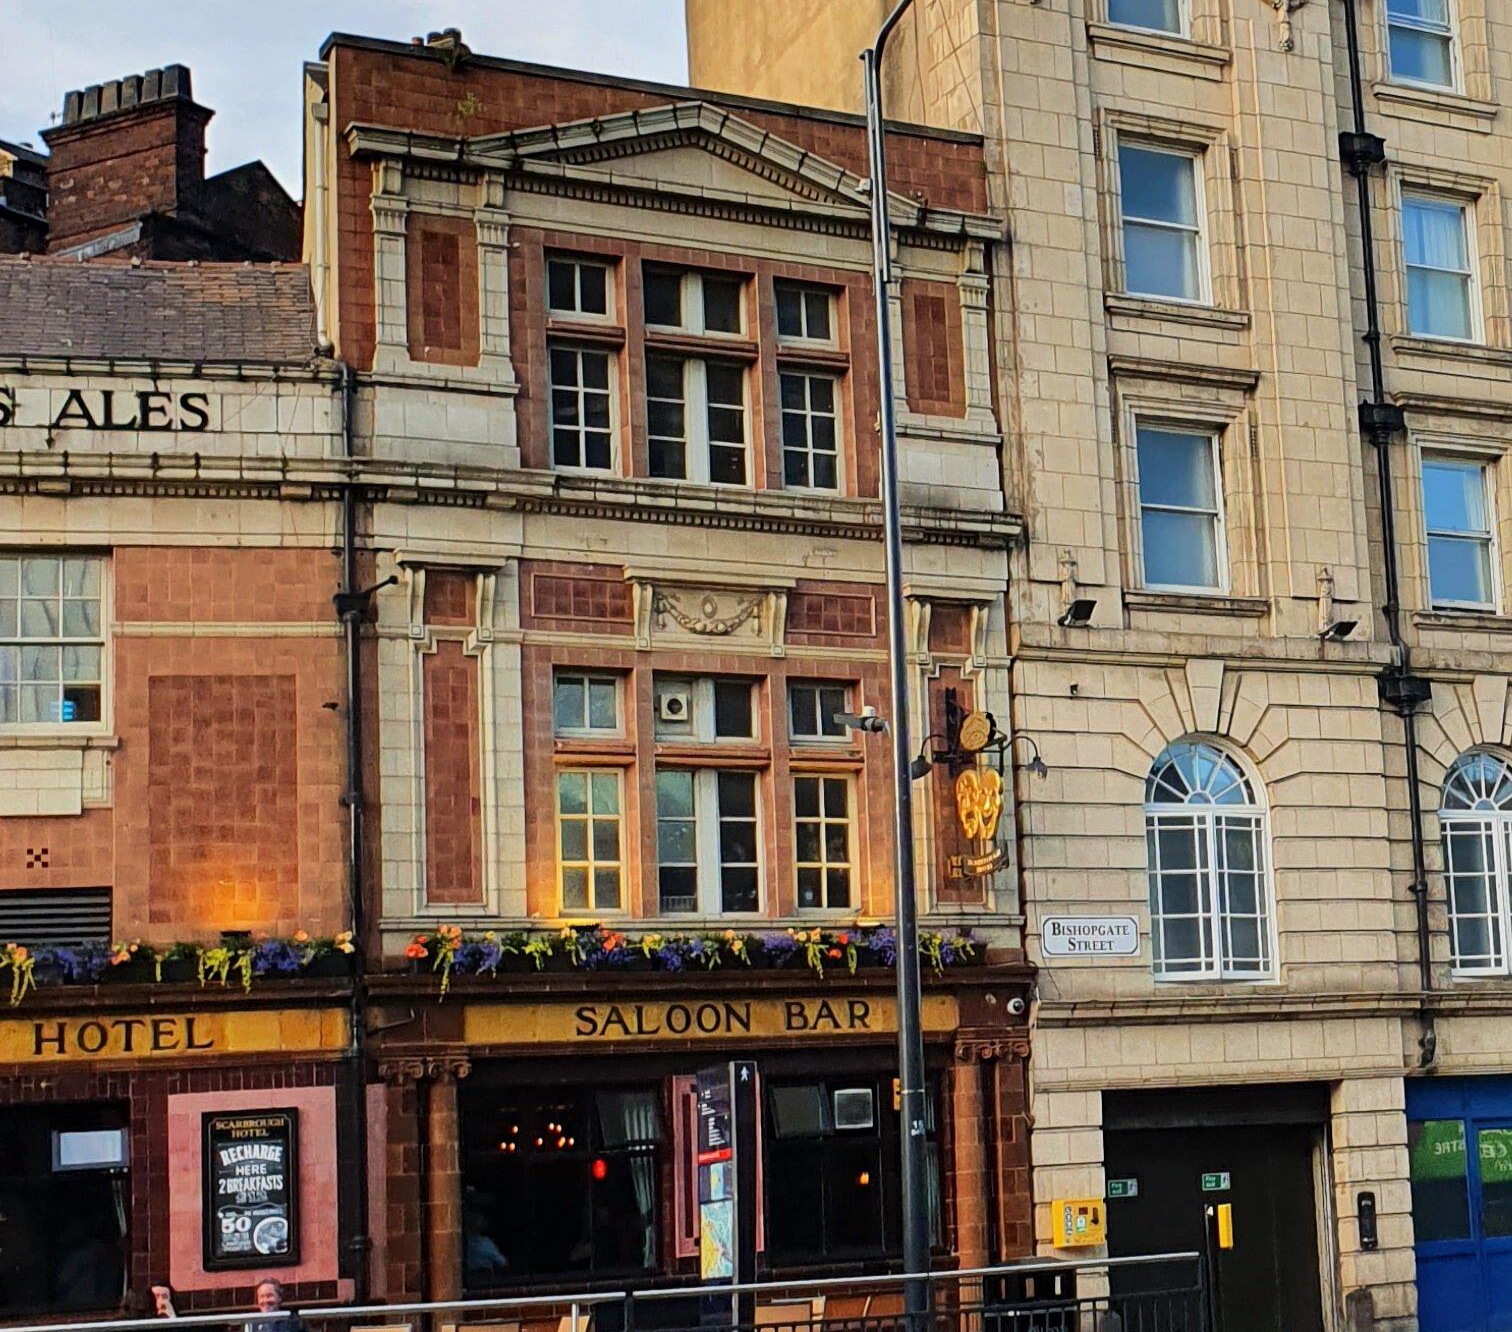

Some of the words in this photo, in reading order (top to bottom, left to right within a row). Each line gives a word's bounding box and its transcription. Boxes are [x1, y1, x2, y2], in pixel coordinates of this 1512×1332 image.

[51, 389, 210, 431] ALES
[1051, 922, 1130, 936] BISHOPGATE
[1068, 937, 1115, 951] STREET
[576, 1001, 750, 1036] SALOON
[784, 999, 871, 1031] BAR
[33, 1017, 215, 1055] HOTEL
[219, 1144, 284, 1166] RECHARGE
[235, 1164, 267, 1176] HERE
[218, 1179, 226, 1194] 2
[226, 1175, 284, 1194] BREAKFASTS
[221, 1217, 252, 1234] 50
